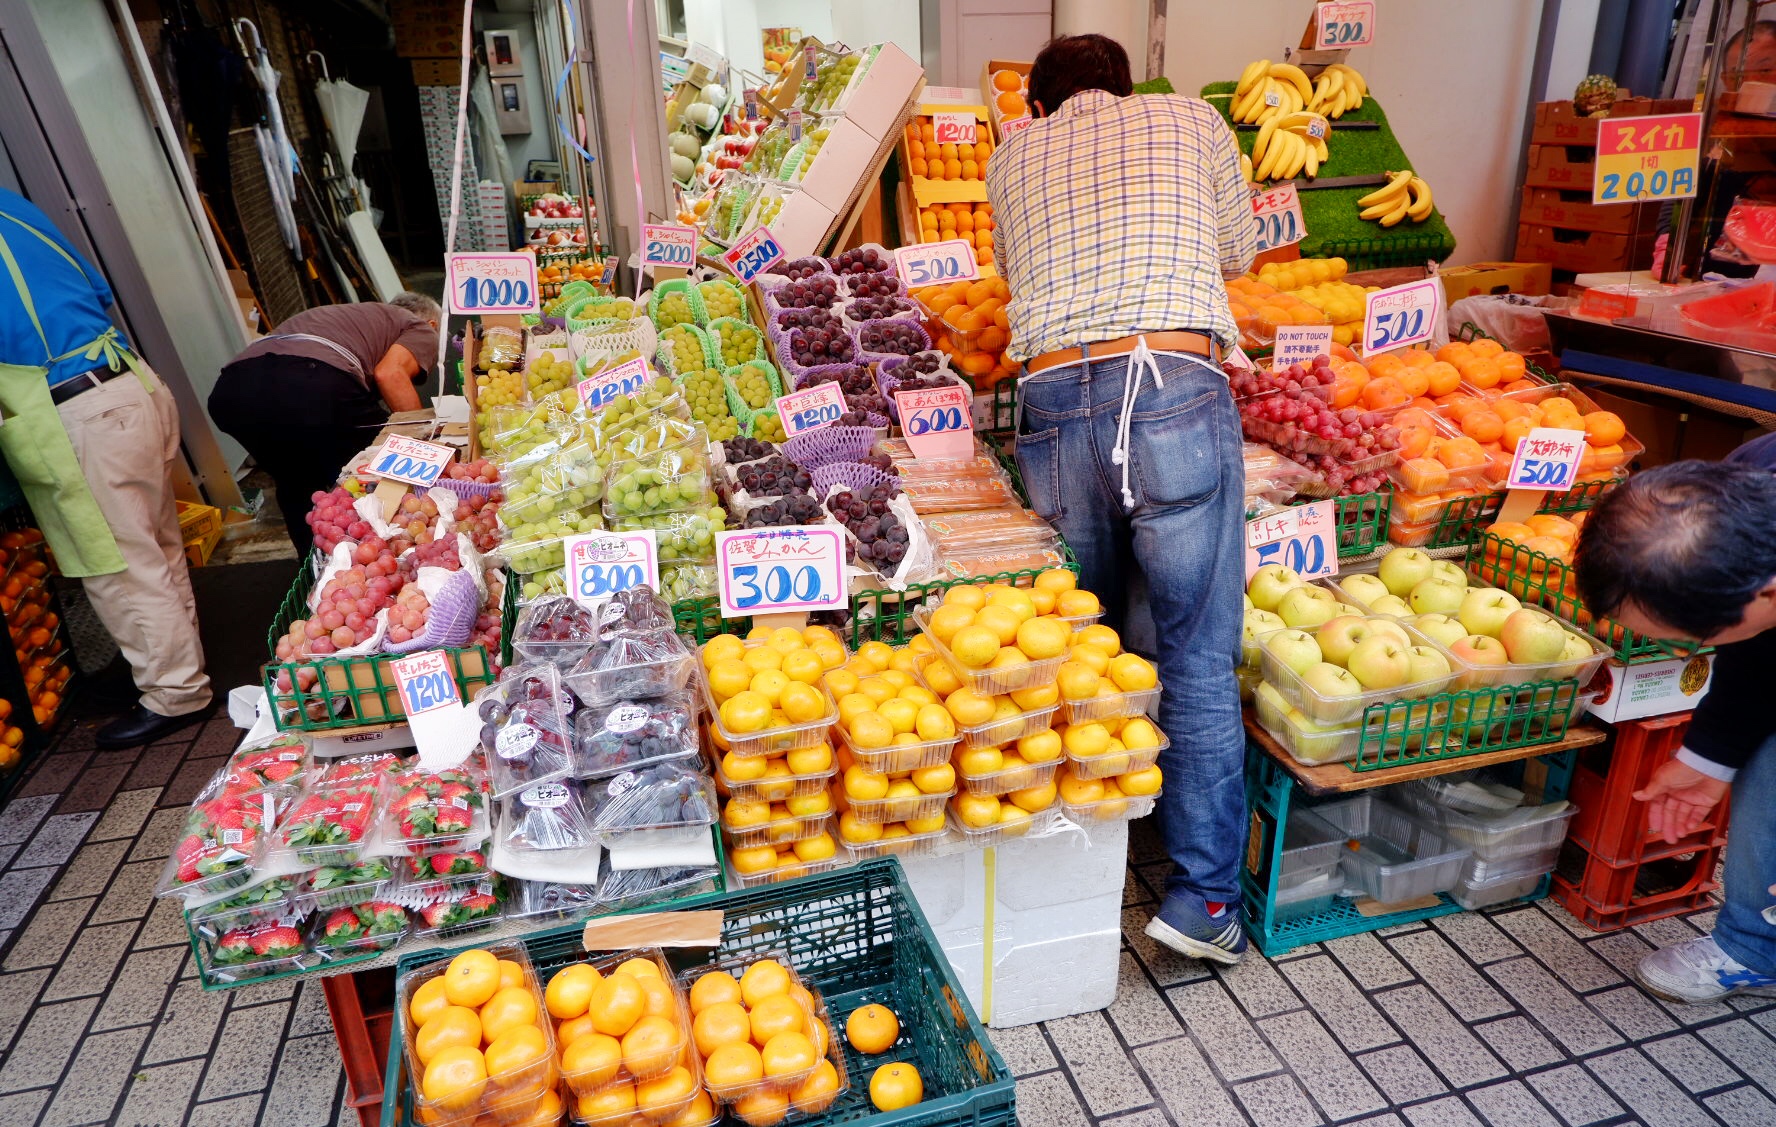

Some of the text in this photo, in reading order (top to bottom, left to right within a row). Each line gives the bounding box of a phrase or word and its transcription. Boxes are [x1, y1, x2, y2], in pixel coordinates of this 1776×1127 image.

[1616, 123, 1685, 153] スイカ
[1600, 167, 1694, 200] 200円
[1251, 191, 1293, 214] レモン
[1278, 332, 1329, 341] DO NOT TOUCH
[1372, 308, 1425, 349] 500円
[1527, 439, 1575, 458] 次郎柿
[1518, 459, 1568, 486] 500円
[1265, 519, 1289, 540] トキ
[580, 564, 644, 597] 800
[732, 564, 831, 608] 300円
